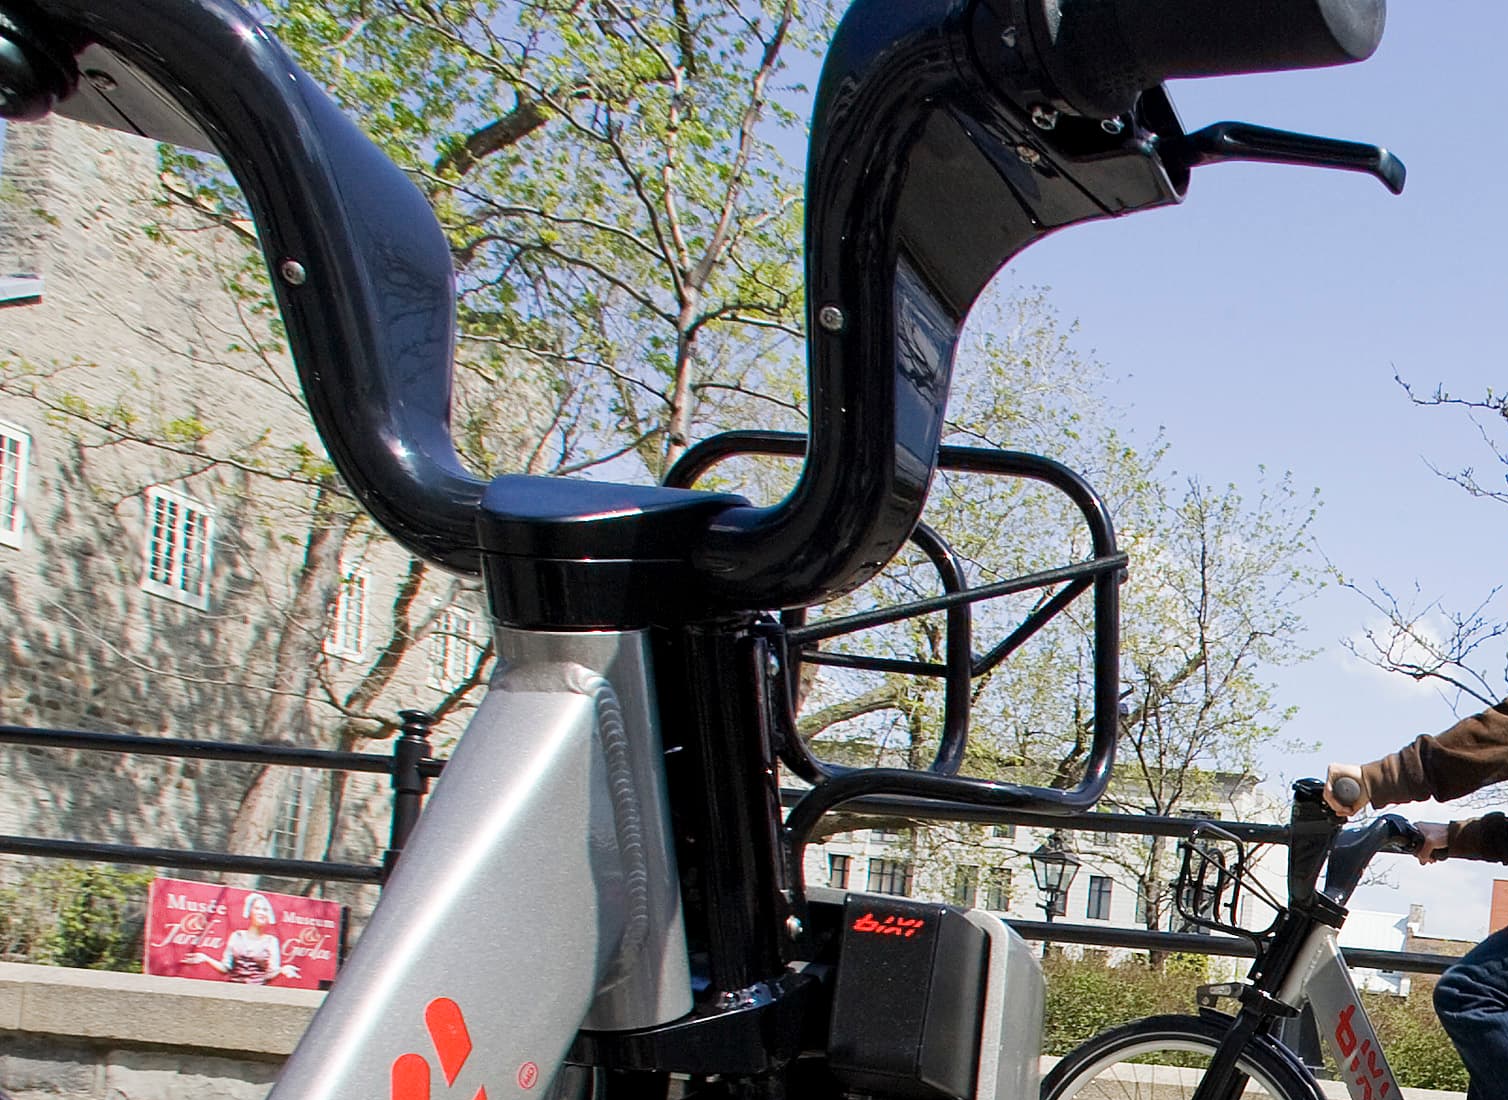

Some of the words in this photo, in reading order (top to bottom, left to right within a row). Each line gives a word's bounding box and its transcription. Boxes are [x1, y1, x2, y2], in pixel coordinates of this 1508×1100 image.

[167, 893, 229, 916] Musée
[282, 911, 336, 929] Museum
[150, 919, 225, 949] Jardin
[281, 934, 333, 963] Garden
